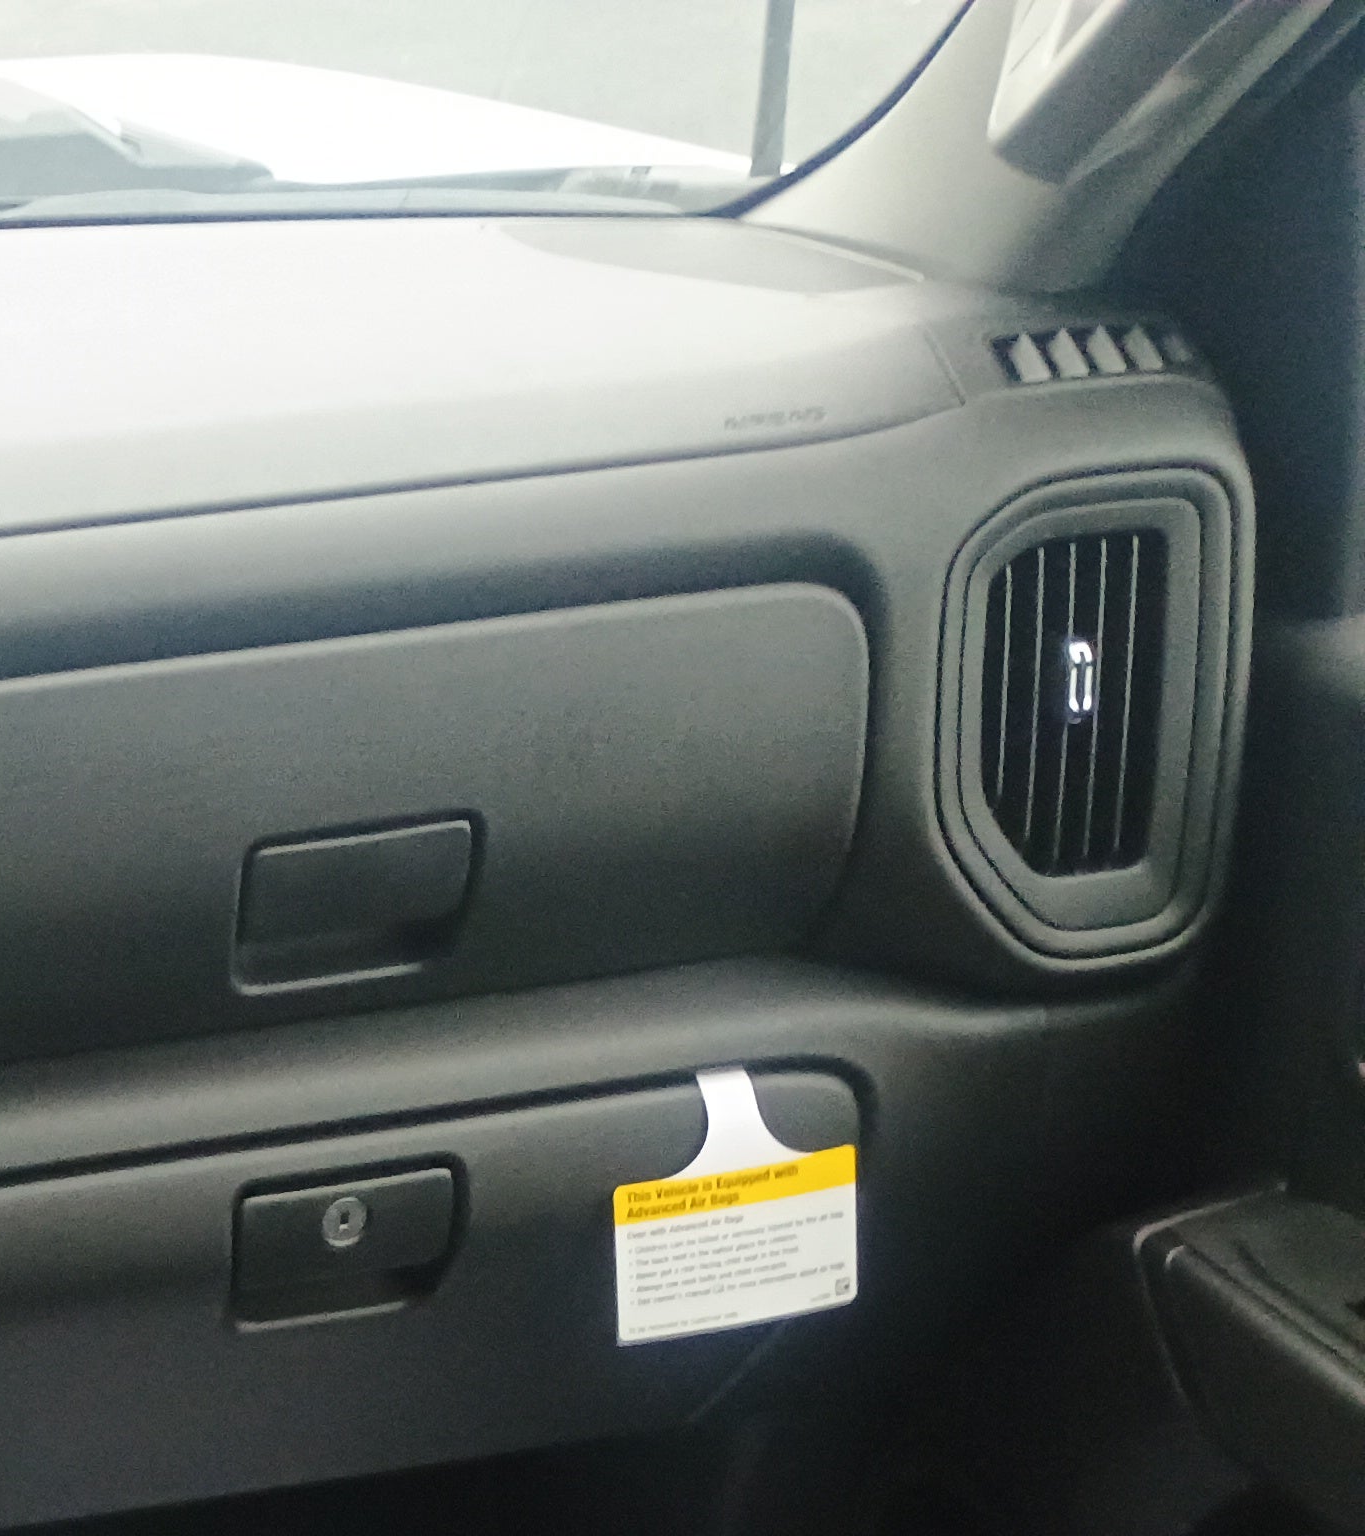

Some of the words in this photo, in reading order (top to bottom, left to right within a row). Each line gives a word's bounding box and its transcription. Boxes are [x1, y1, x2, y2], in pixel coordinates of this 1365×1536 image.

[627, 1190, 652, 1203] This
[656, 1183, 699, 1199] Vehicle
[702, 1181, 712, 1191] is
[716, 1170, 770, 1190] Equipped
[774, 1165, 799, 1178] with
[627, 1200, 687, 1218] Advanced
[690, 1196, 707, 1209] Air
[711, 1191, 740, 1206] Bags
